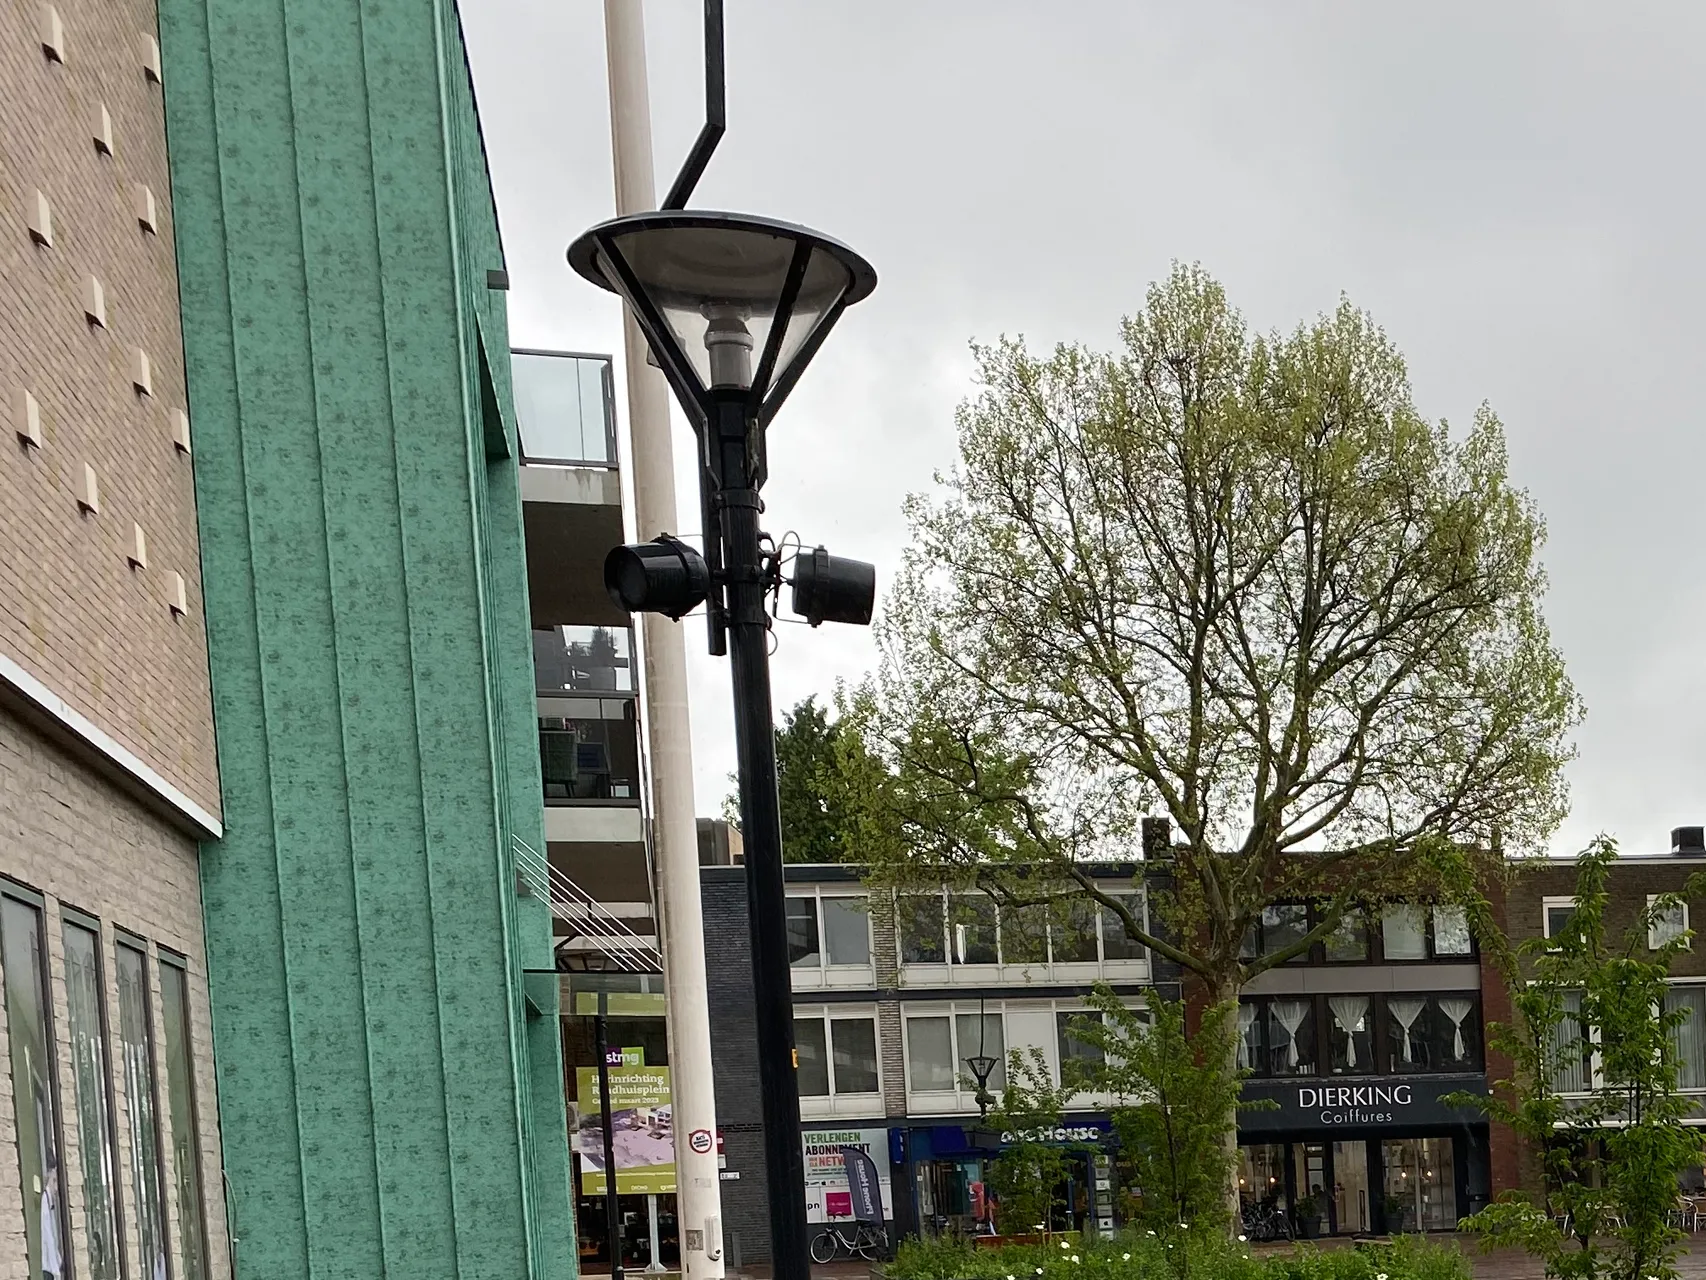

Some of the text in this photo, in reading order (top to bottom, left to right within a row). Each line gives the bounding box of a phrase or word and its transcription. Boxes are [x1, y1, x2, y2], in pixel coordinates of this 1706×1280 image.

[592, 1074, 664, 1085] Hrinrichting
[592, 1085, 670, 1096] Rdhuisplein
[1299, 1085, 1411, 1108] DIERKING
[1320, 1109, 1392, 1124] Coiffures
[804, 1132, 860, 1144] VERLENGEN
